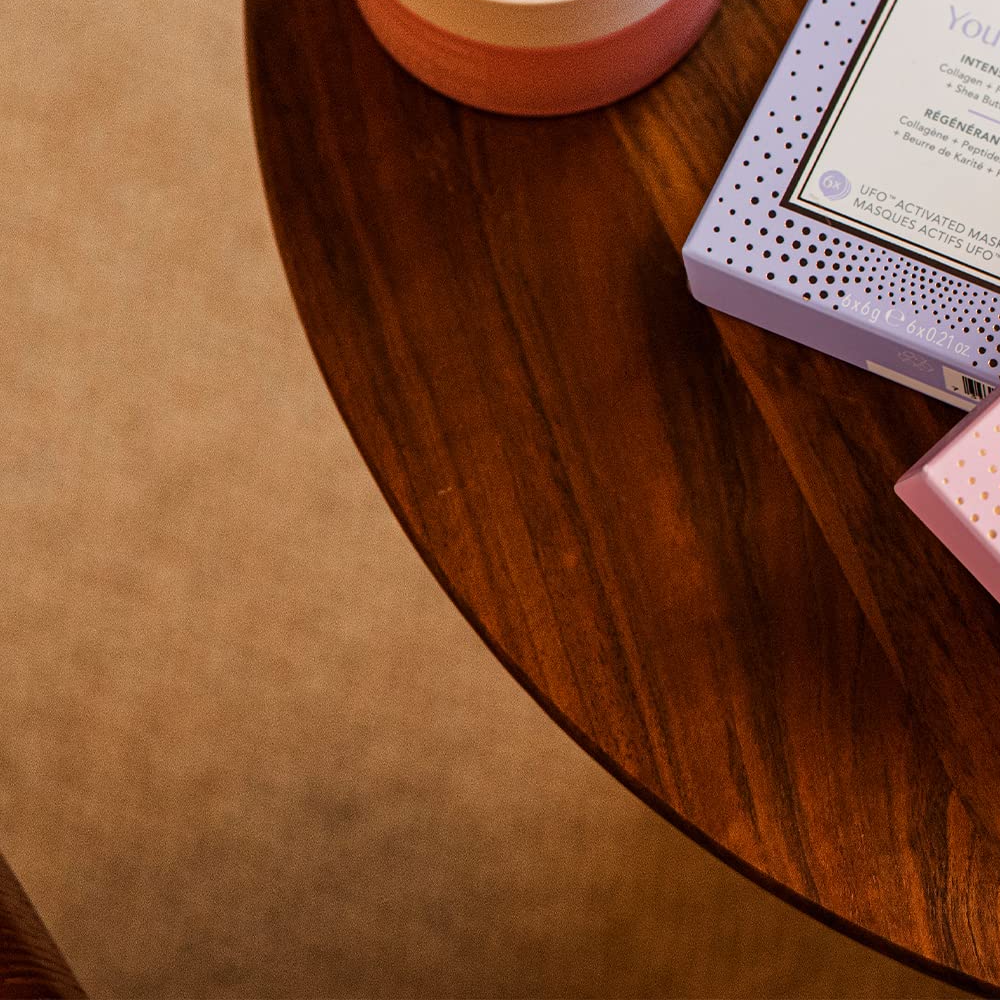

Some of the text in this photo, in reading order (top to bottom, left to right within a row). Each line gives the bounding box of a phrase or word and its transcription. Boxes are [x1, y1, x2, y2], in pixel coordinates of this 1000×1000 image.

[939, 63, 983, 86] Collagen
[955, 84, 980, 100] Shea
[899, 115, 949, 142] Collagène
[902, 131, 936, 151] Beurre
[937, 147, 951, 157] de
[953, 152, 984, 170] Karité
[853, 197, 917, 230] MASQUES
[917, 224, 964, 249] ACTIFS
[894, 200, 966, 234] ACTIVATED
[841, 294, 881, 323] 6x6g
[906, 321, 954, 350] 6x0.21
